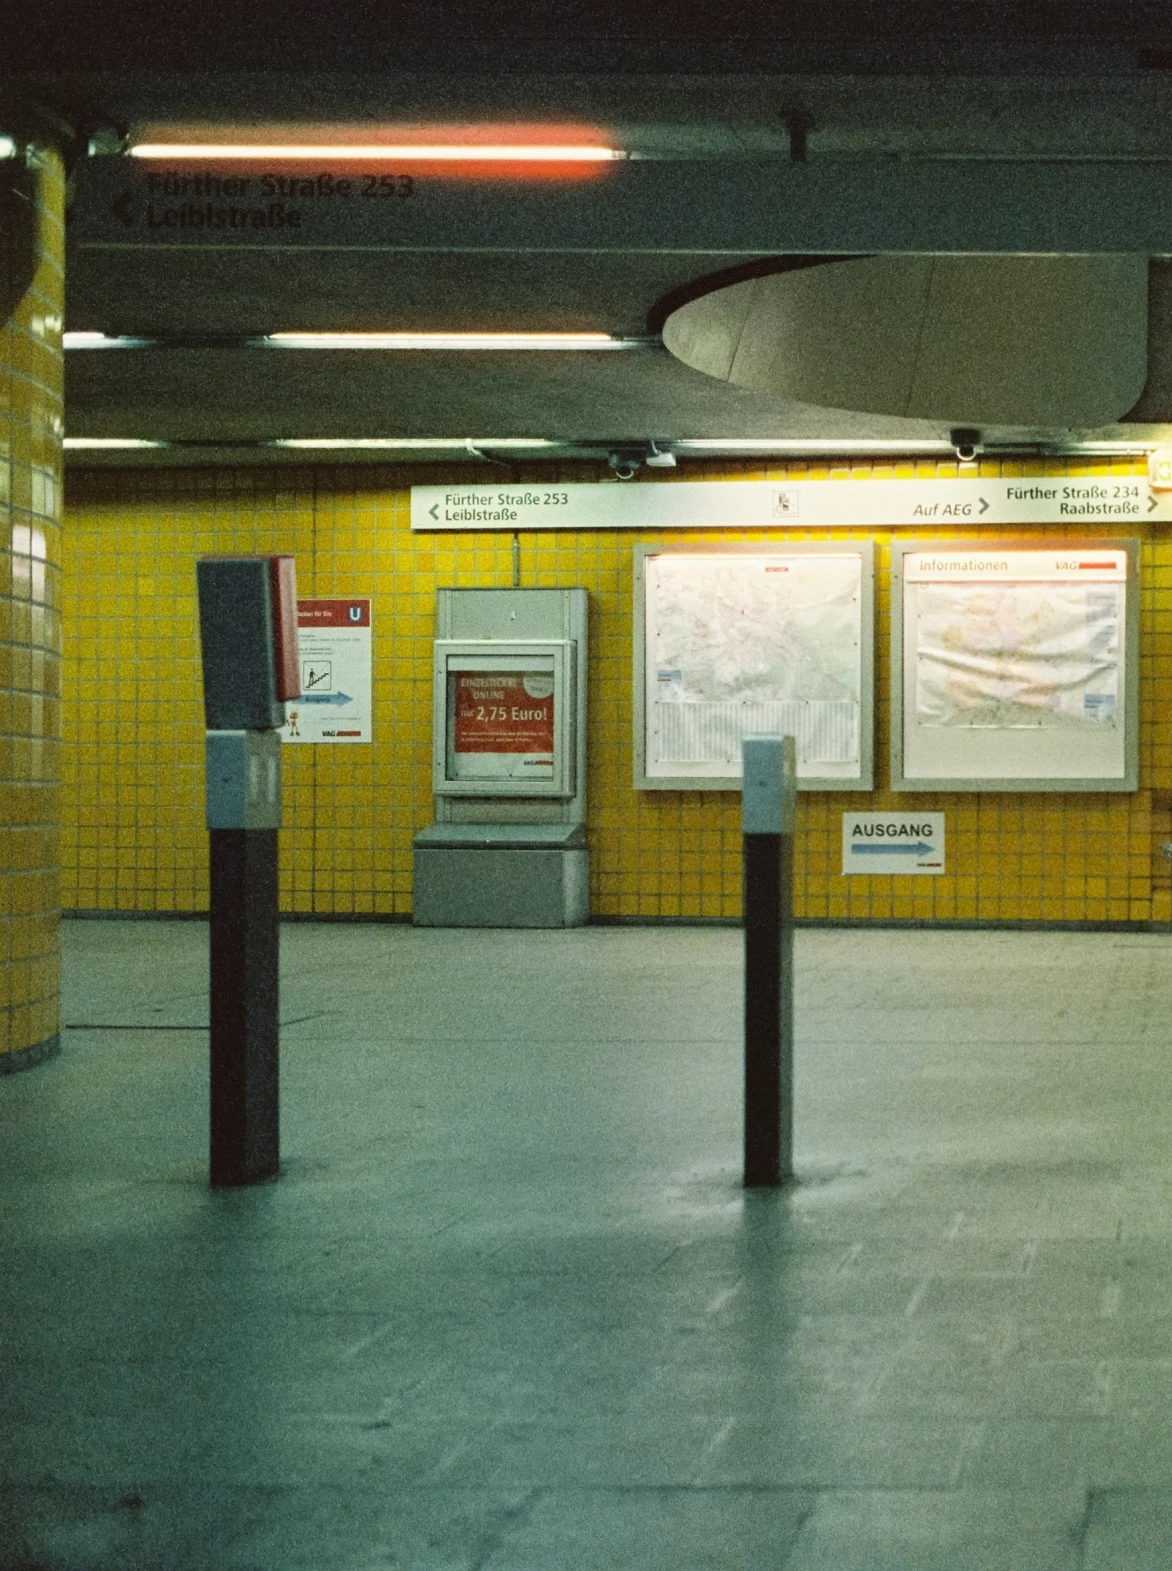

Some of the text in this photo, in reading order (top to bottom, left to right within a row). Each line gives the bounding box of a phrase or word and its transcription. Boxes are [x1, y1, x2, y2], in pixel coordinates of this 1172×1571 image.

[148, 172, 414, 199] Fürther Straße 253
[148, 202, 302, 228] Leiblstraße
[445, 493, 569, 506] Fürther Straße 253
[1006, 485, 1140, 500] Fürther Straße 234
[445, 507, 518, 522] Leiblstraße
[913, 503, 972, 517] Auf AEG
[1060, 501, 1140, 516] Raabstraße
[919, 559, 1078, 571] Informationen VAG
[350, 608, 361, 621] U
[473, 690, 505, 700] ONLINE
[476, 706, 507, 722] 2,75
[512, 706, 548, 721] Euro!
[852, 824, 934, 837] AUSGANG
